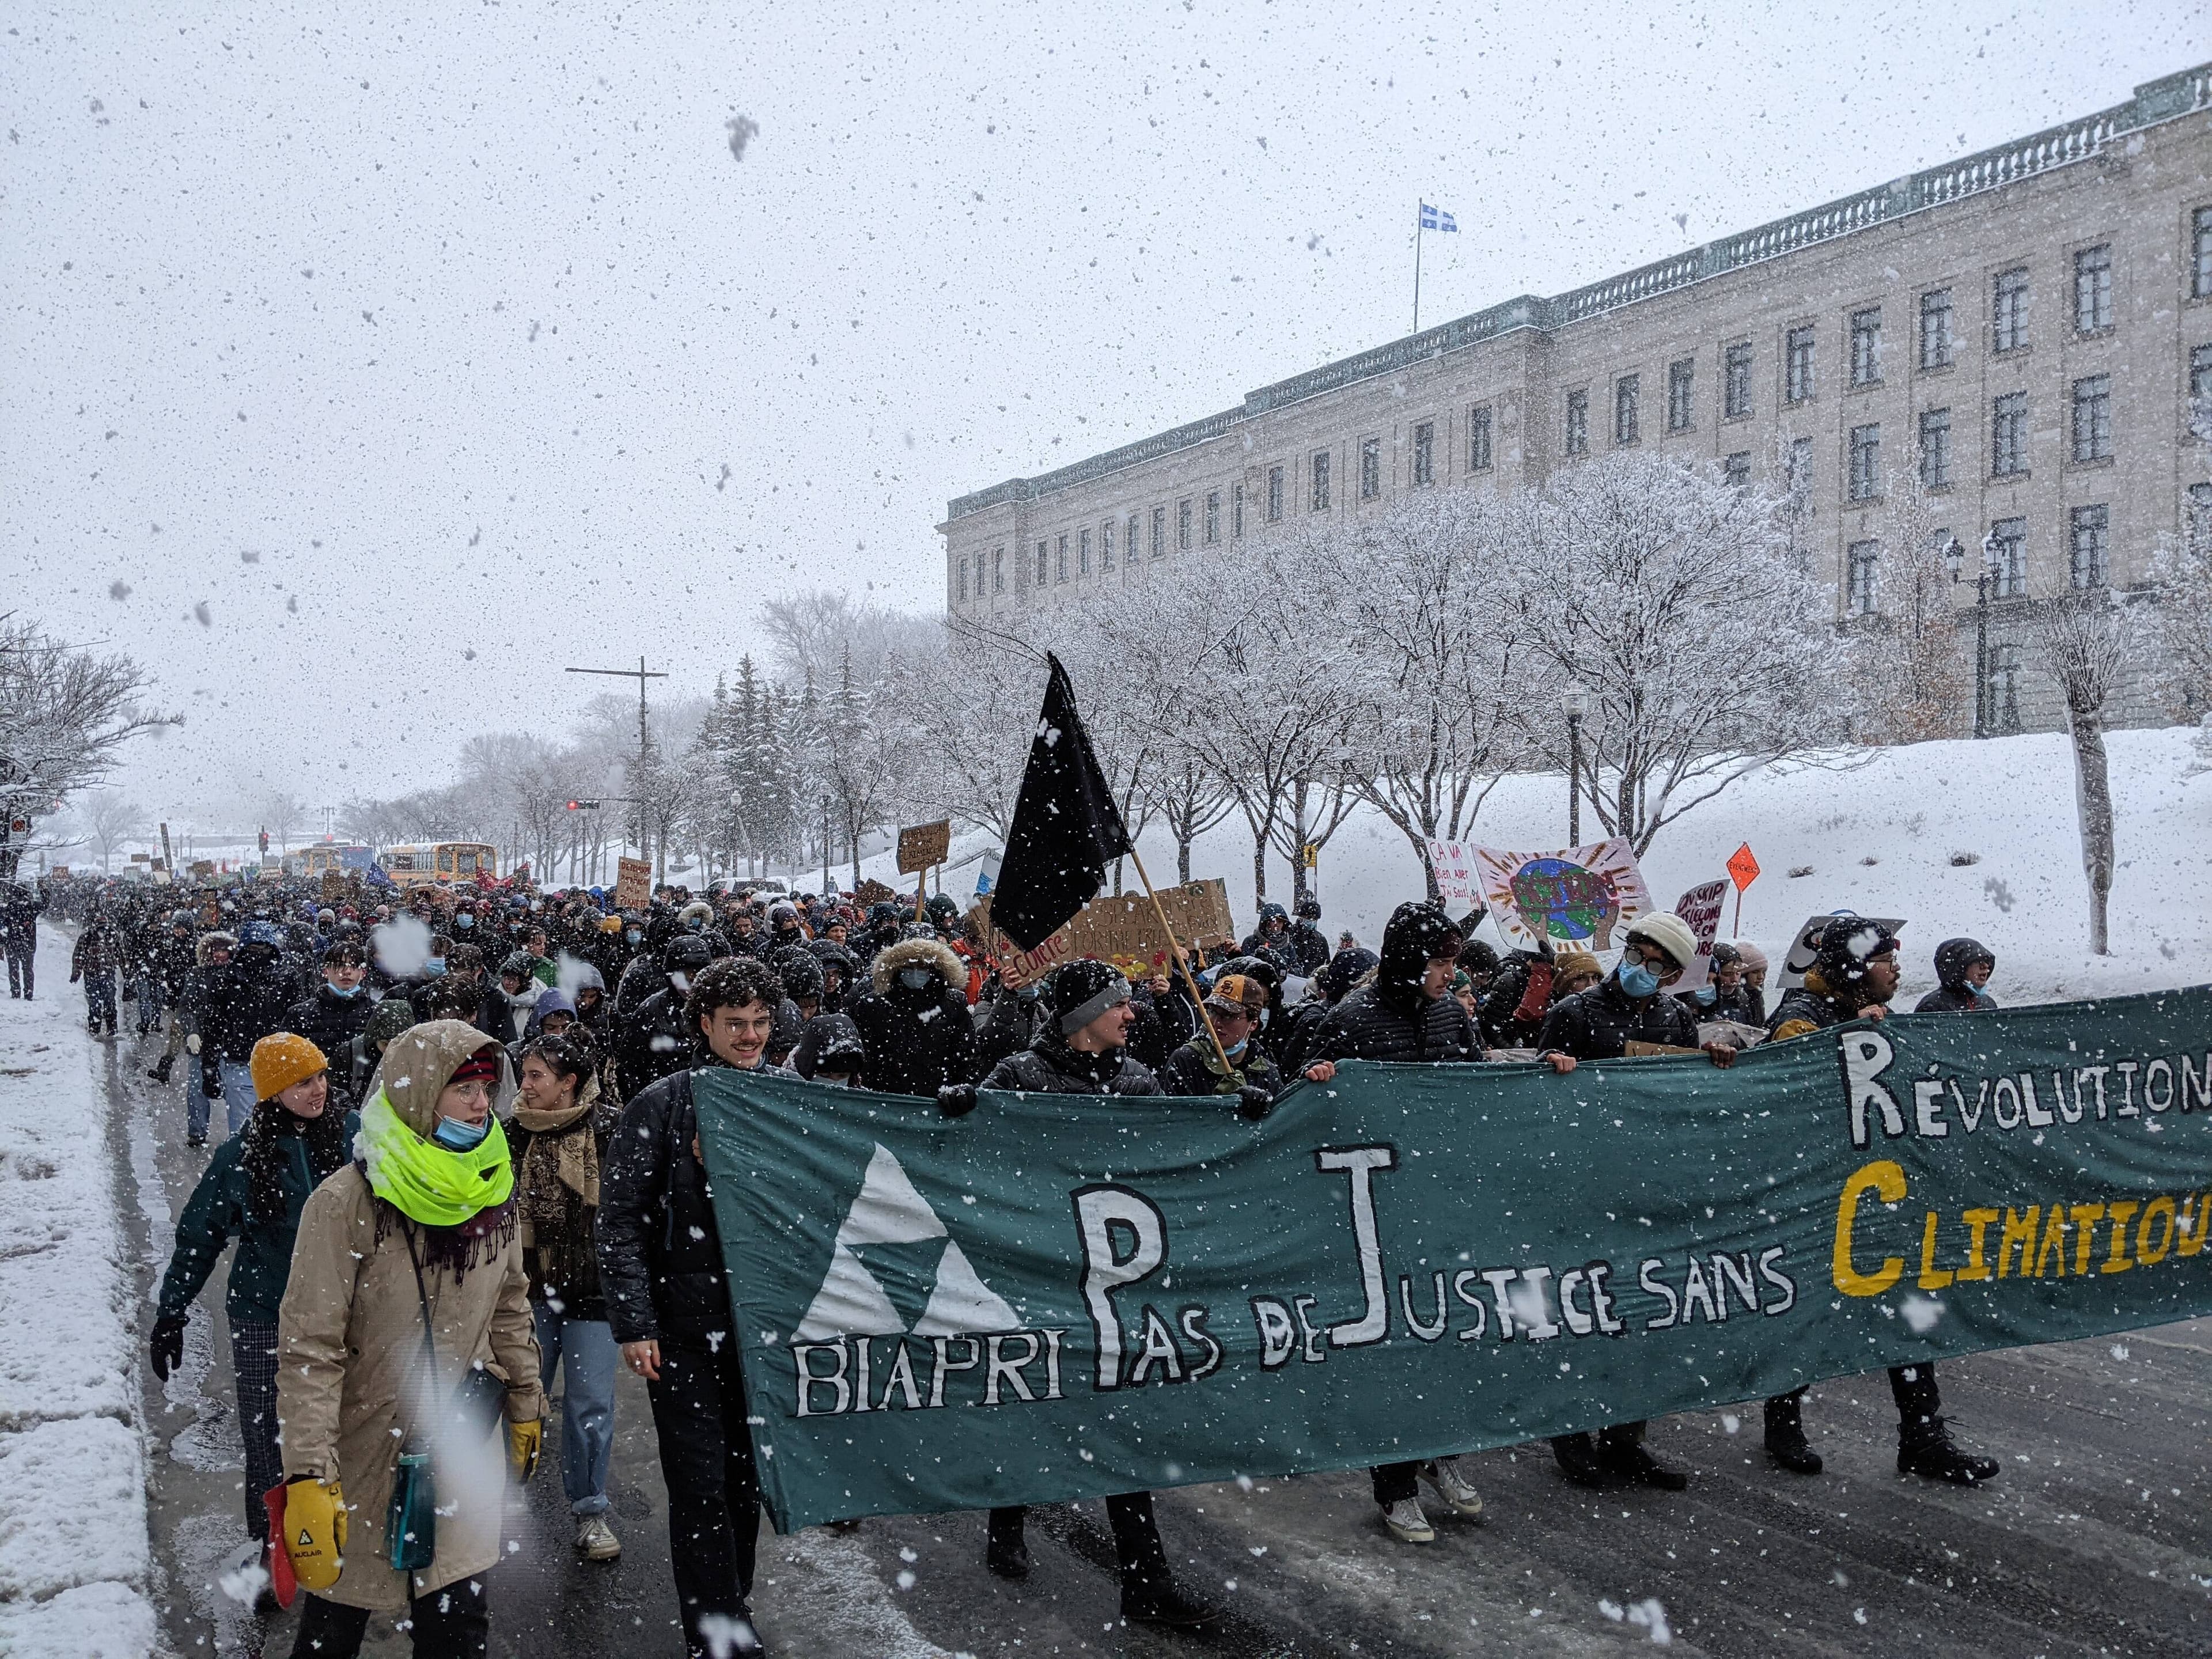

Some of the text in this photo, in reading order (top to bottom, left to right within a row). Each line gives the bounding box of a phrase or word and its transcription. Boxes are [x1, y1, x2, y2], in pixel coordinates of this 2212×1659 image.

[1446, 843, 1463, 859] VA
[1696, 882, 1724, 903] SKIP
[1096, 902, 1160, 927] SPEAK
[1839, 1027, 2212, 1151] RÉVOLUTION
[787, 1143, 1797, 1418] BIAPRI PAS DE JUSTICE SANS
[294, 1550, 322, 1558] AUCLAIR
